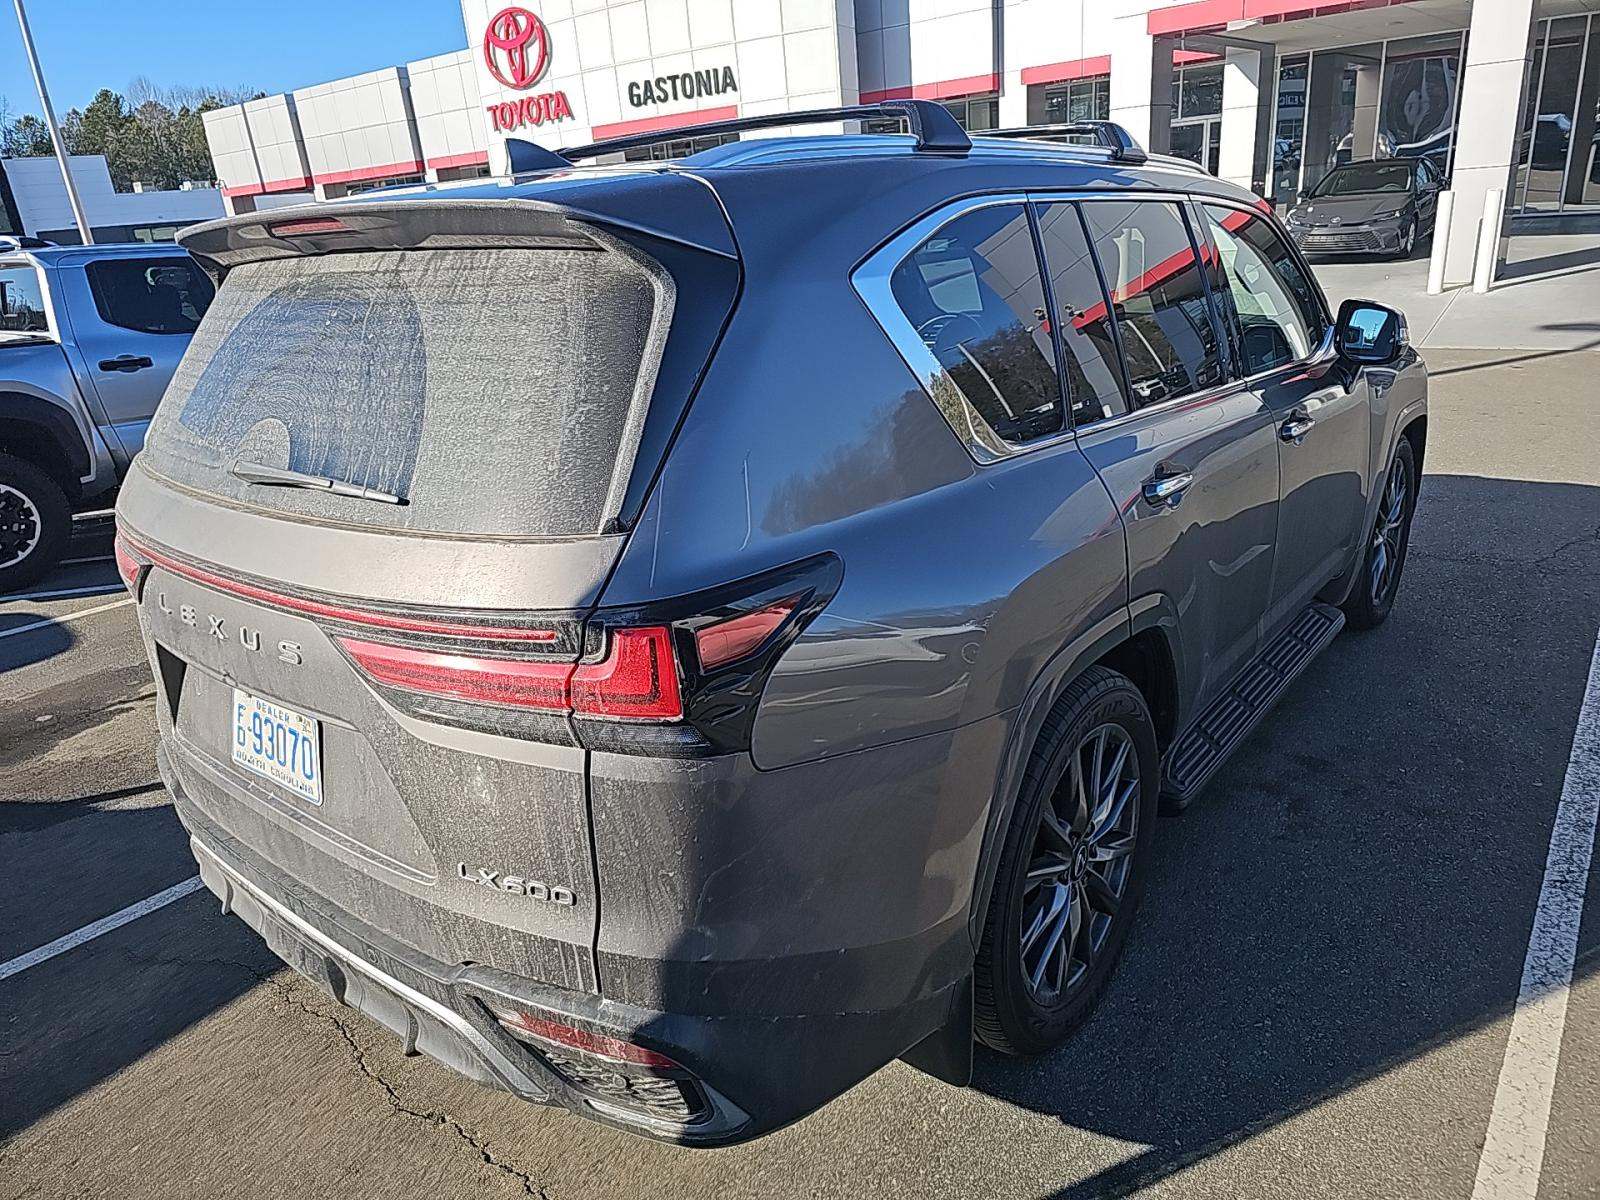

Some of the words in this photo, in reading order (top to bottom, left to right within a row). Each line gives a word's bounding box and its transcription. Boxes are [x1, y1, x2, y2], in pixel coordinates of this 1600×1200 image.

[628, 66, 737, 107] GASTONIA
[486, 91, 574, 132] TOYOTA
[158, 593, 302, 665] LEXUS
[256, 699, 290, 721] DEALER
